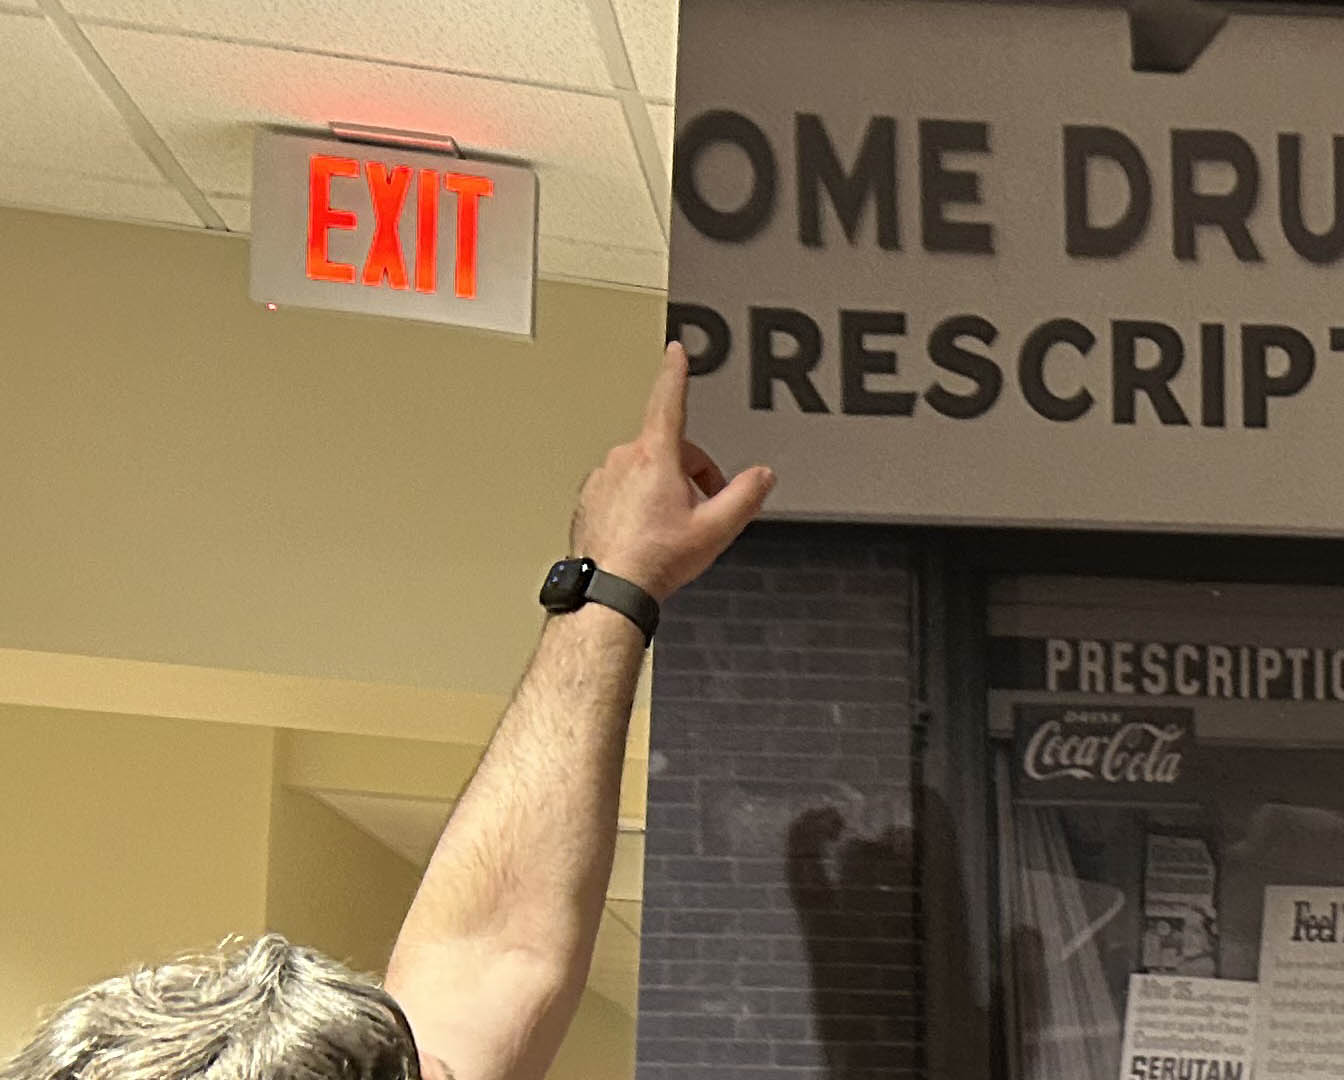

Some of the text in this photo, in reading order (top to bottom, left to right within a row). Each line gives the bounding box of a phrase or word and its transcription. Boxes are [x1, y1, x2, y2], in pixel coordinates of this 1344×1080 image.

[305, 154, 494, 300] EXIT
[673, 109, 997, 256] OME
[1024, 720, 1186, 783] Coca-Cola
[1291, 900, 1338, 943] Feel
